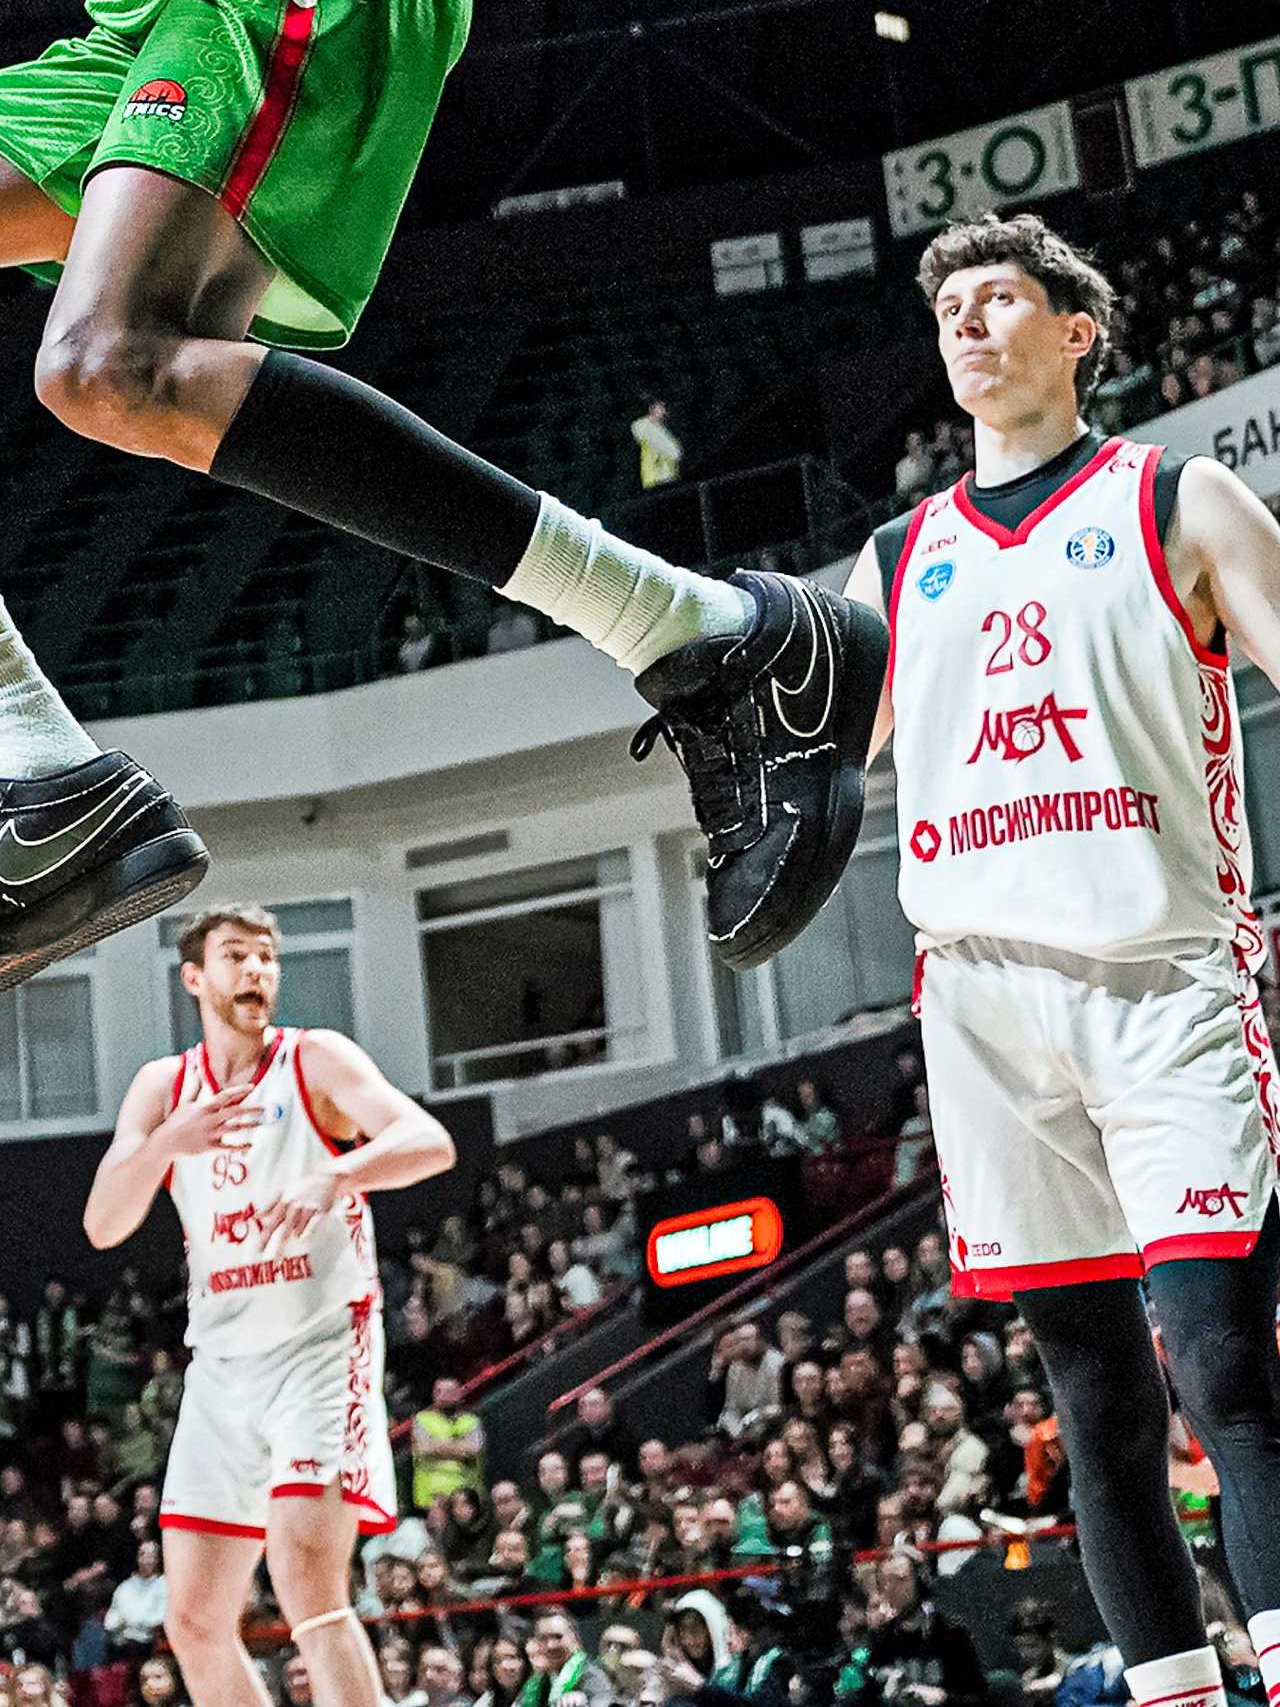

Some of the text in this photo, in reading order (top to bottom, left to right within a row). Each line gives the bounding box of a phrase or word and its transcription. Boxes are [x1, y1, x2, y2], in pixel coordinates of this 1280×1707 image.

[122, 102, 186, 121] UNICS
[981, 600, 1052, 676] 28
[948, 786, 1161, 856] МОСИНЖПРОЕКТ
[212, 1148, 248, 1190] 95
